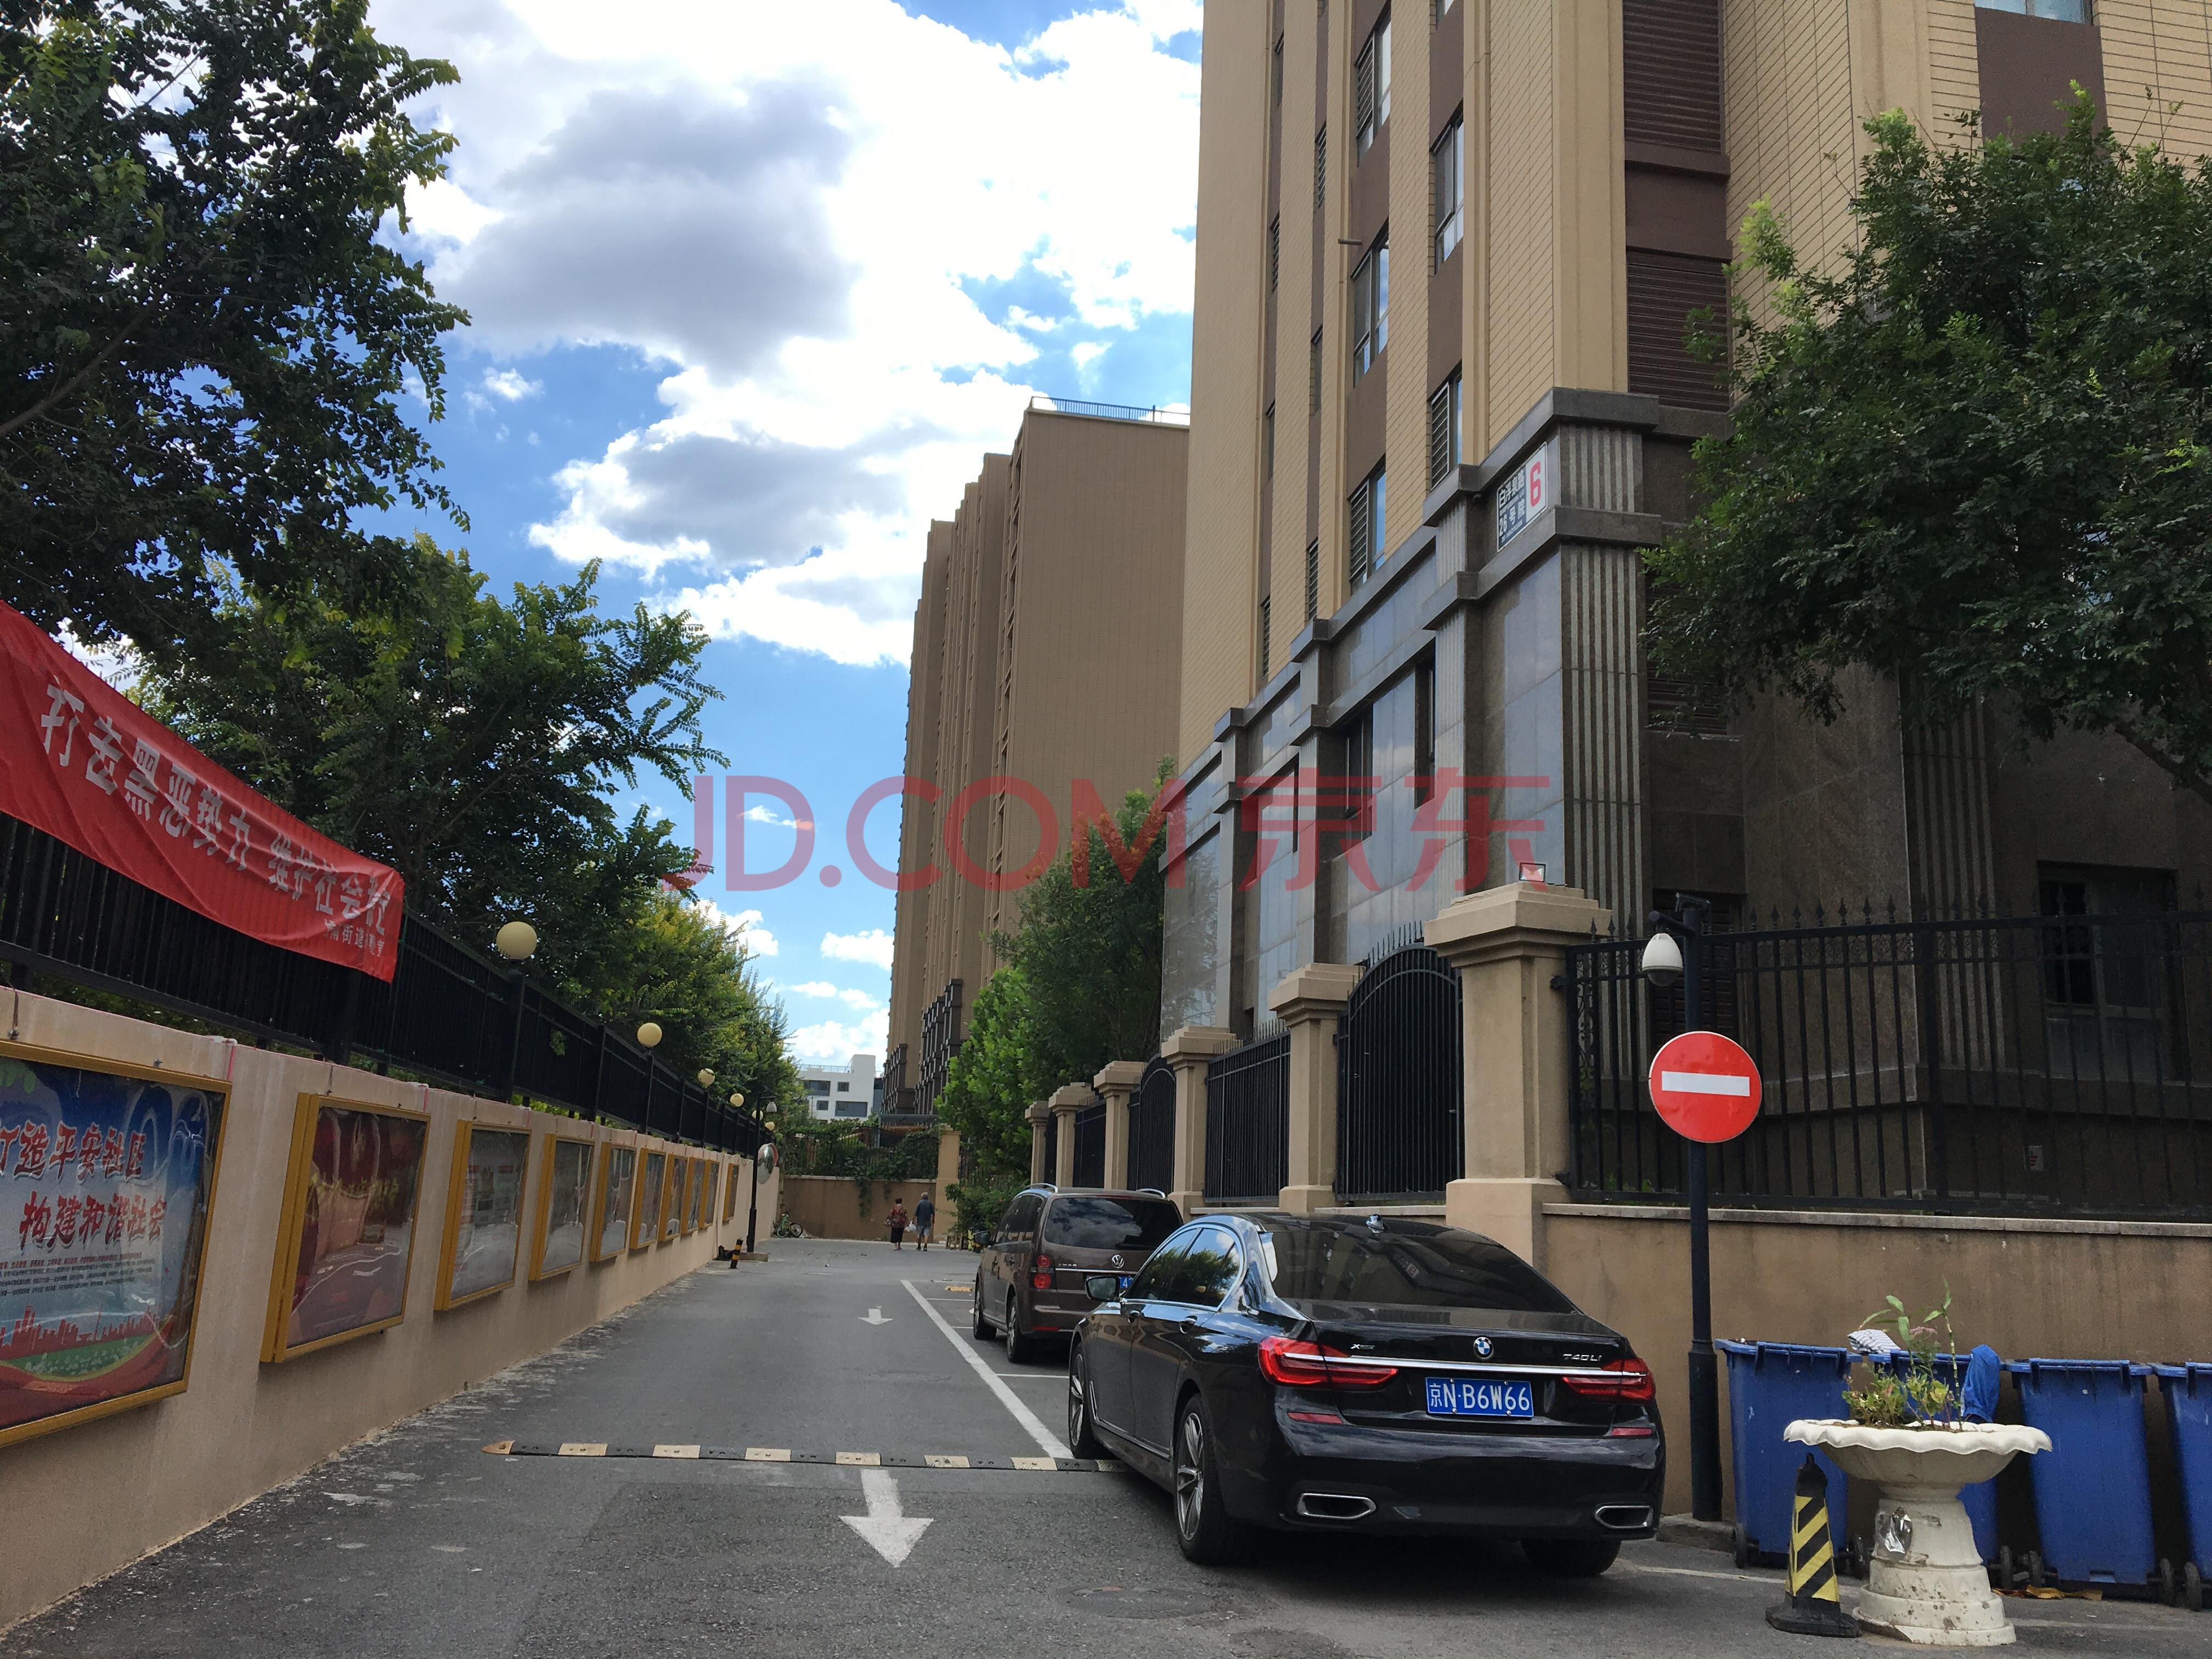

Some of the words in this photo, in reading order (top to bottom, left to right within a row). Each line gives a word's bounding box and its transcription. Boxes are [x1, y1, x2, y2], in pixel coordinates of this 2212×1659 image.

[1530, 461, 1541, 507] 6
[41, 675, 250, 871] 打击黑恶势力
[19, 1190, 167, 1251] 构建和谐社会
